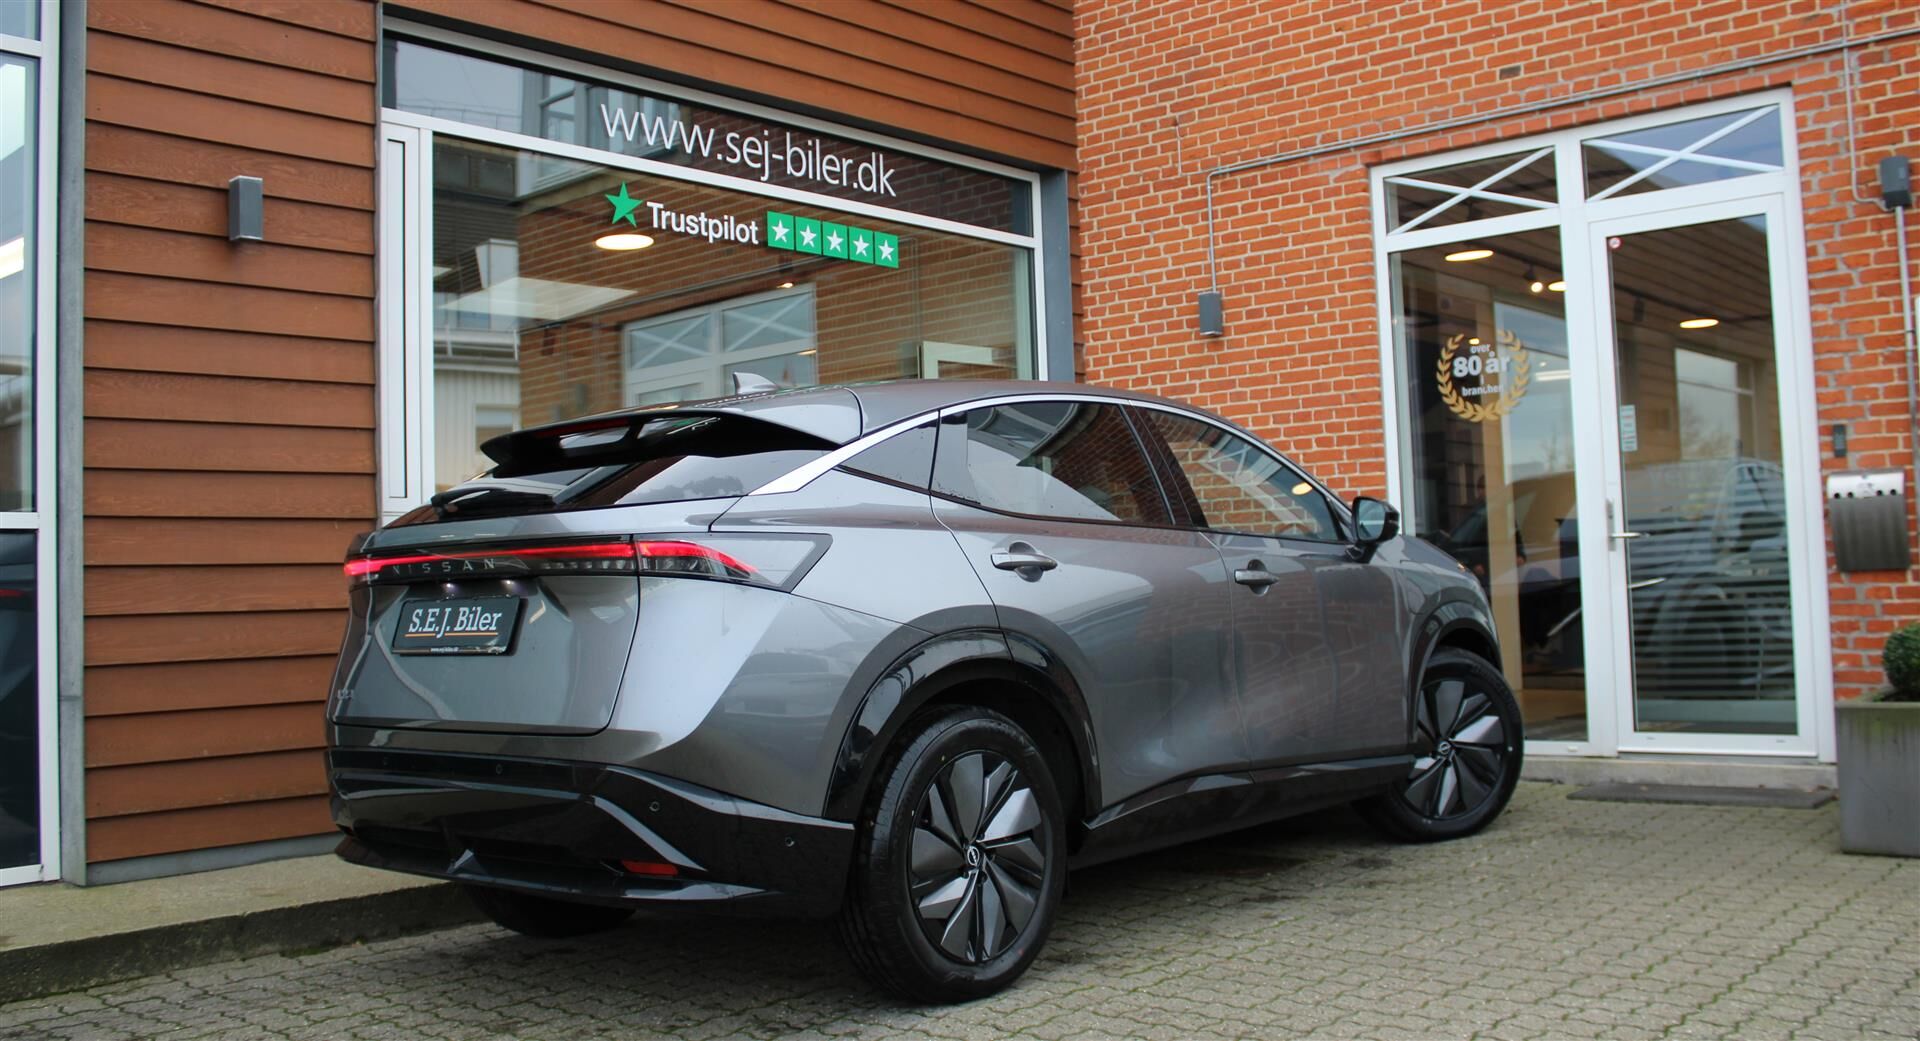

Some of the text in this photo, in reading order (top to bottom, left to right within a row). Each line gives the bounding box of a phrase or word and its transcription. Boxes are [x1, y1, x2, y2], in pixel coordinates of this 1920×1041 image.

[601, 103, 896, 197] www.sej-biler.dk
[646, 201, 759, 244] Trustpilot
[1471, 344, 1490, 353] over
[1454, 351, 1510, 377] 80 år
[393, 558, 495, 574] NISSAN
[408, 606, 502, 638] S.E.J. Biler
